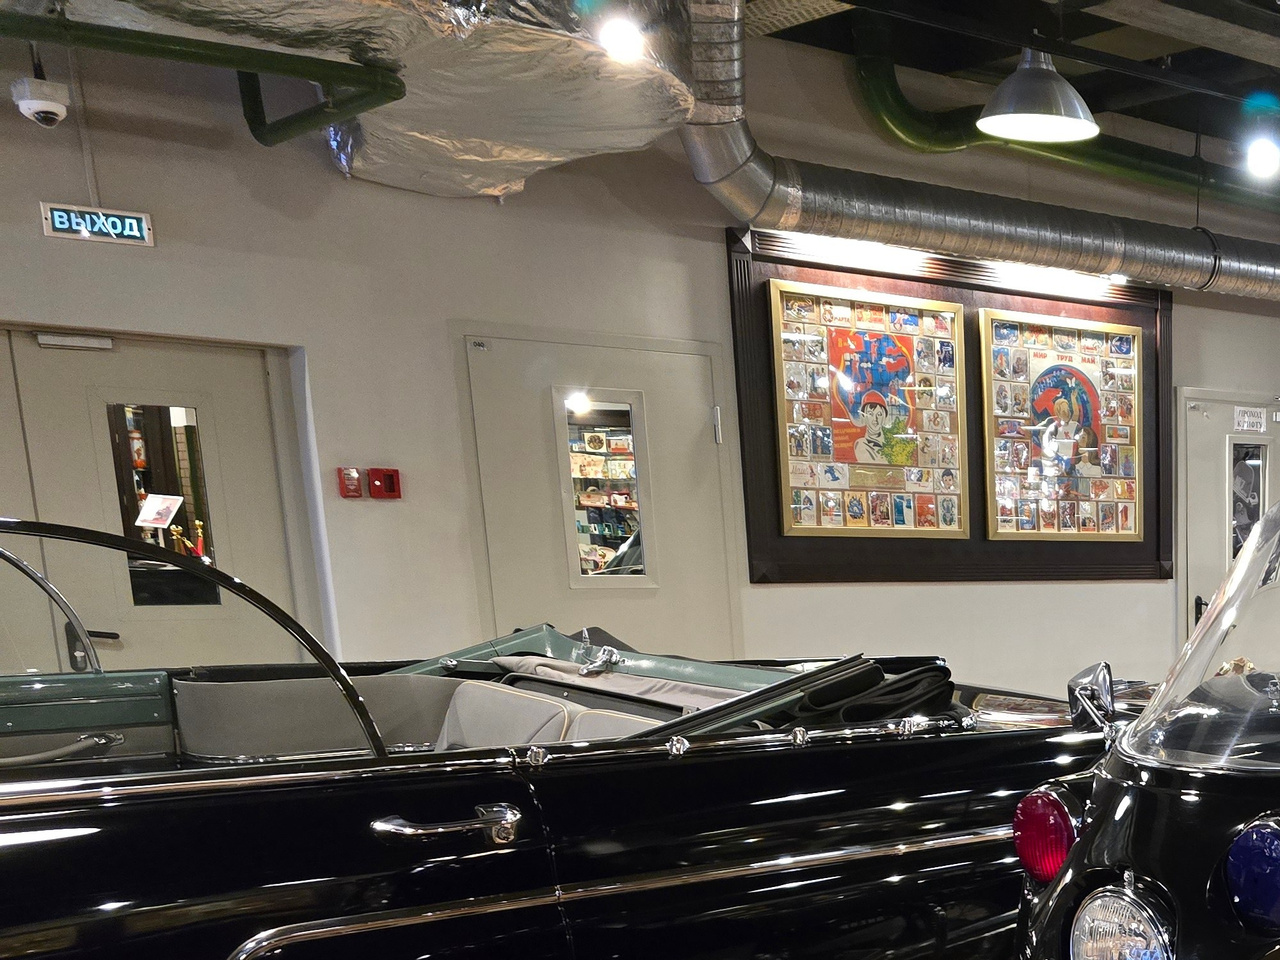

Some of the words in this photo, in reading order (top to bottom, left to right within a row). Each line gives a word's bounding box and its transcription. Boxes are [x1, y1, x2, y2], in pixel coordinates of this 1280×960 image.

[53, 211, 140, 236] ВЫХОД
[1033, 351, 1048, 359] МИР
[1056, 354, 1073, 362] ТРУД
[1081, 356, 1096, 364] МАЙ
[1238, 409, 1262, 419] ПРОХОД
